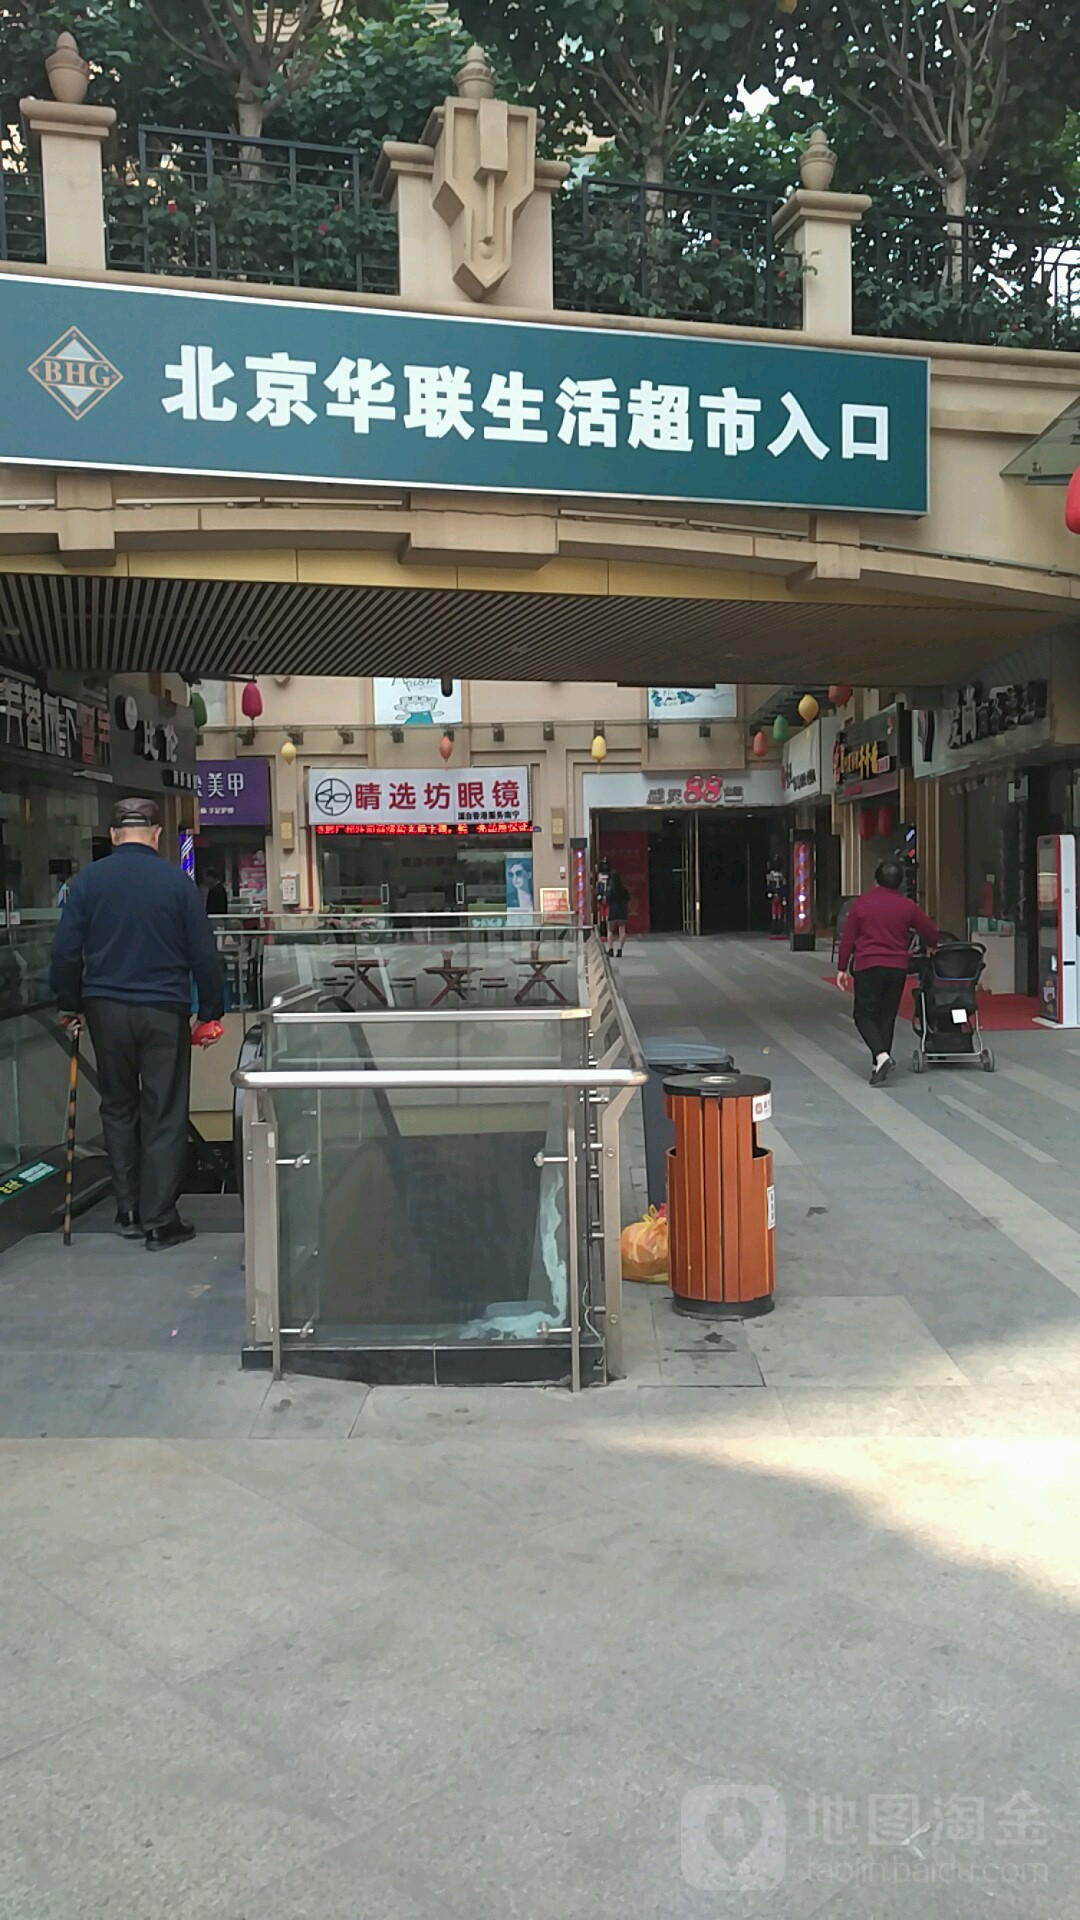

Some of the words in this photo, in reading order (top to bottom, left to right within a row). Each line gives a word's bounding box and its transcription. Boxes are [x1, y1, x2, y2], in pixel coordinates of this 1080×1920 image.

[43, 360, 110, 386] BHG
[162, 345, 890, 462] 北京华联生活超市入口
